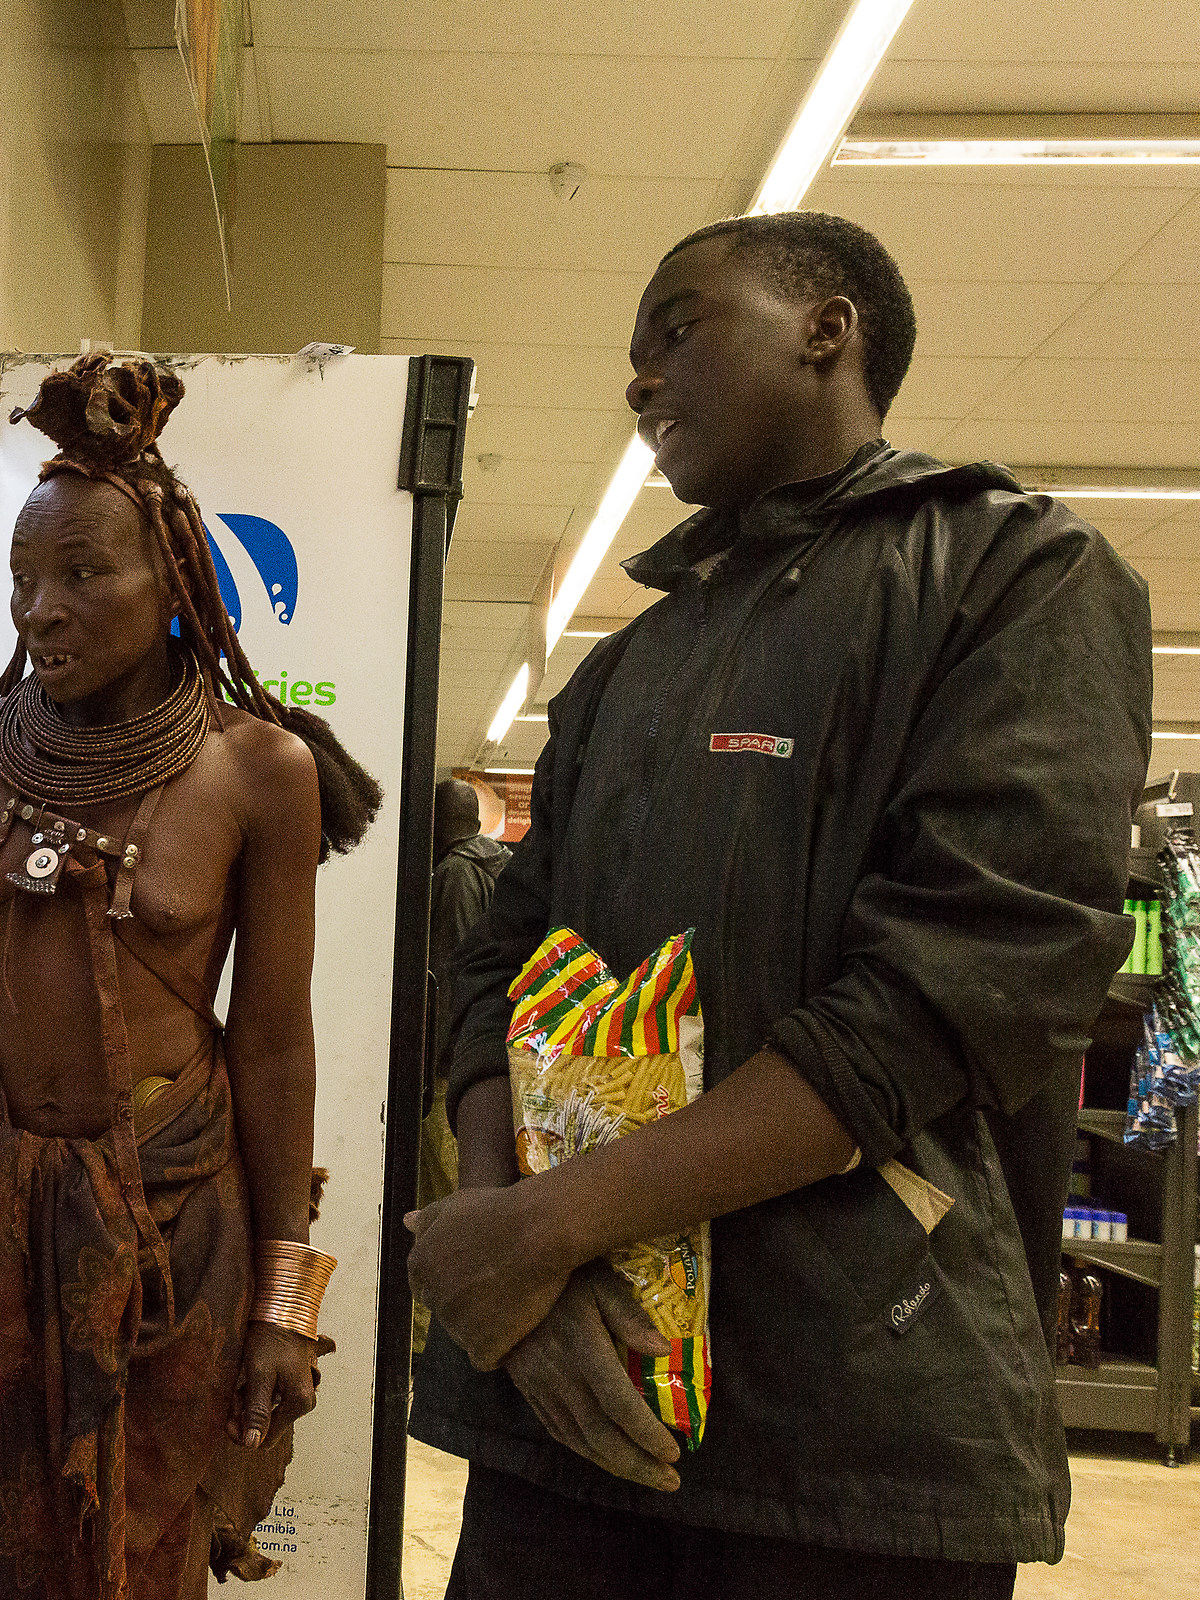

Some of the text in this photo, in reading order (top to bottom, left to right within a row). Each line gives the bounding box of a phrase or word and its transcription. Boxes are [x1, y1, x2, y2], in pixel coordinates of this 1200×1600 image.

[728, 737, 774, 750] SPAR
[891, 1282, 931, 1326] Rolando
[253, 1521, 299, 1537] amibia.
[256, 1540, 298, 1554] com.na
